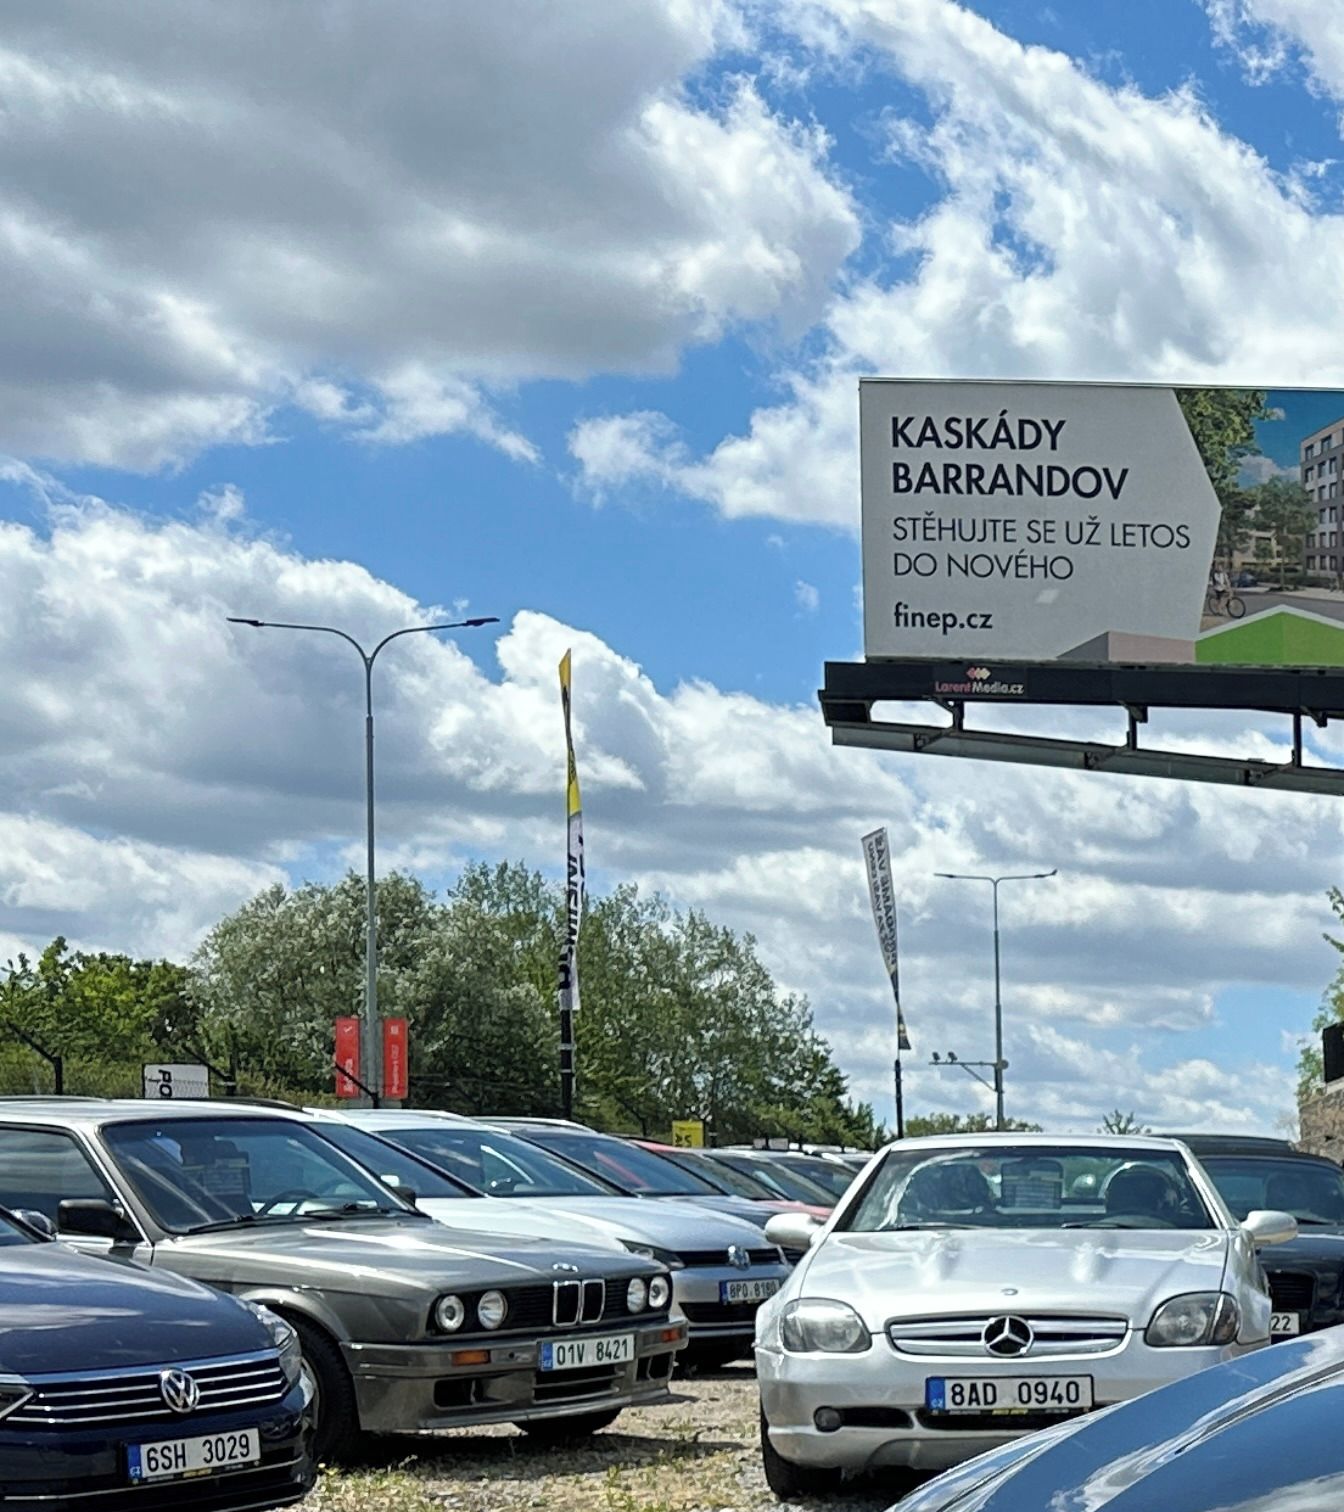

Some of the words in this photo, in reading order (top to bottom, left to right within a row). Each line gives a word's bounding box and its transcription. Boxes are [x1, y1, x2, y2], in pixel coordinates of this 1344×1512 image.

[891, 409, 1067, 451] KASKÁDY
[892, 462, 1130, 500] BARRANDOV
[893, 511, 1017, 544] STĚHUJTE
[1026, 519, 1057, 545] SE
[1065, 515, 1102, 547] UŽ
[1110, 522, 1191, 549] LETOS
[893, 552, 938, 577] DO
[948, 548, 1074, 580] NOVÉHO
[893, 601, 993, 635] finep.cz
[557, 1343, 585, 1366] 01V
[596, 1338, 628, 1362] 8421
[951, 1382, 998, 1407] 8AD
[1018, 1380, 1080, 1405] 0940
[146, 1442, 187, 1473] 6SH
[202, 1433, 250, 1464] 3029
